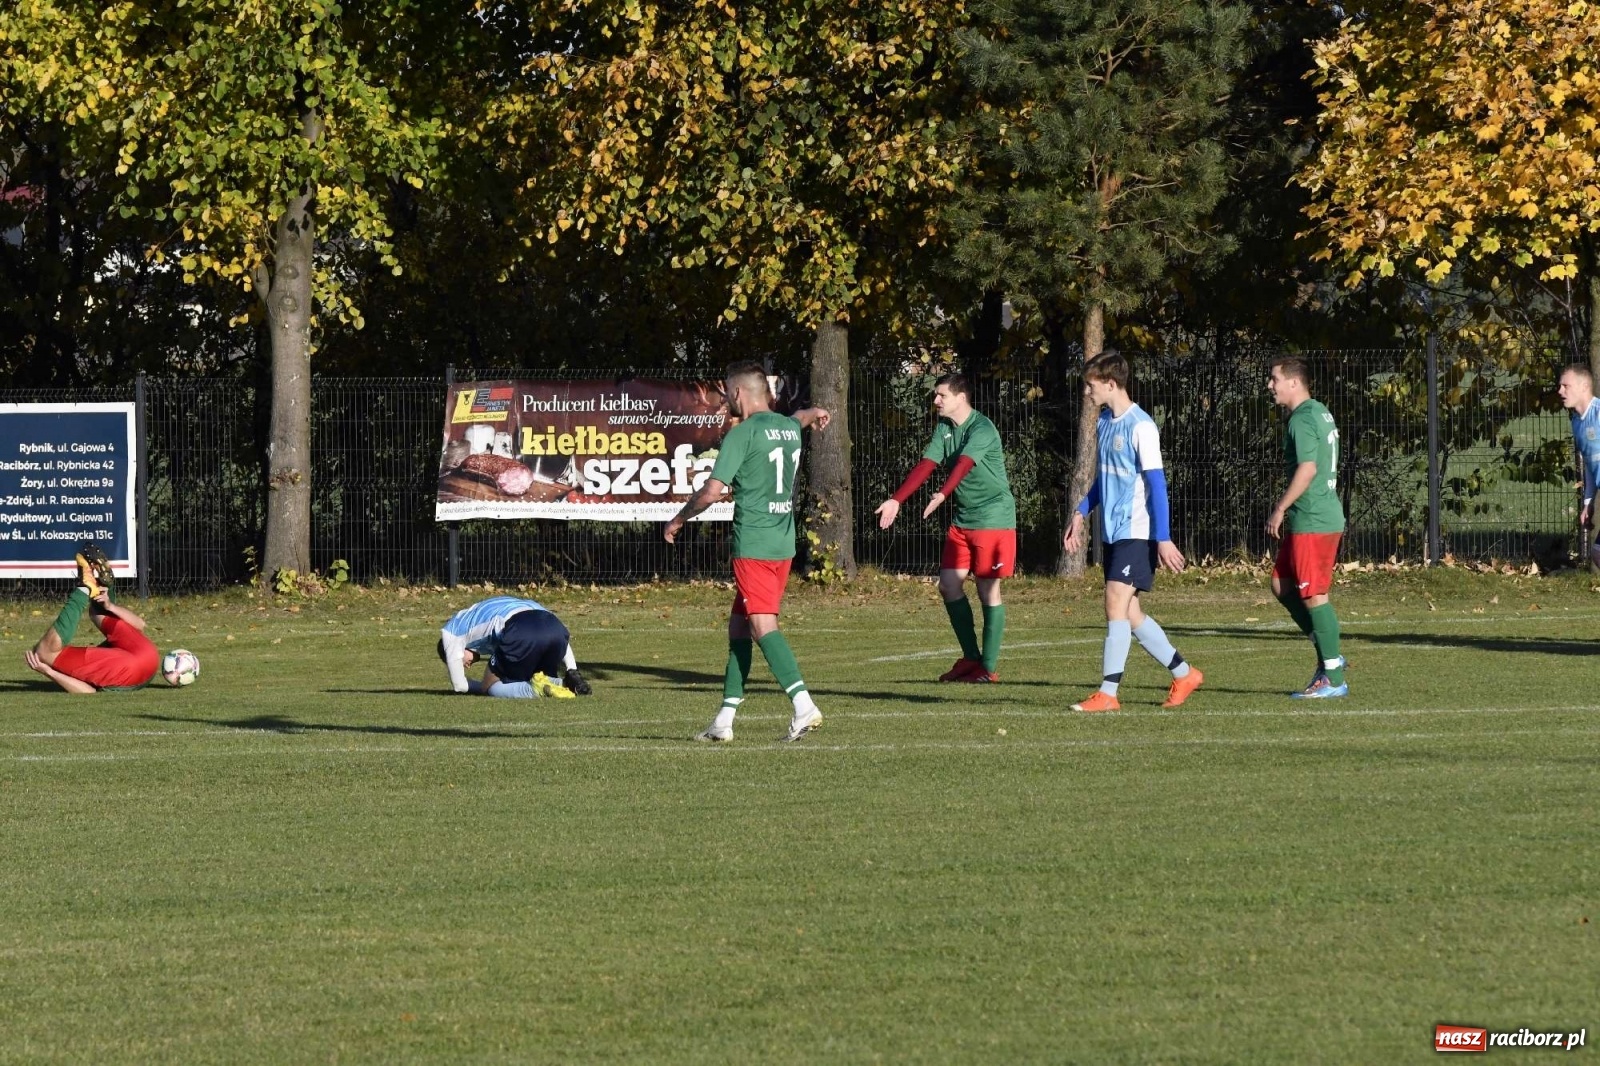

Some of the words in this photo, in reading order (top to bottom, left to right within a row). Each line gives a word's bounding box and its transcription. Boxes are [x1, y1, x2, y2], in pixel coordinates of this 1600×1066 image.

[522, 394, 596, 412] Producent
[600, 393, 657, 416] kiełbasy
[607, 410, 727, 429] surowo-dojrzewającej
[520, 425, 668, 455] kiełbasa
[19, 443, 55, 454] Rybnik,
[57, 443, 69, 452] ul.
[71, 443, 106, 454] Gajowa
[107, 443, 115, 452] 4
[43, 460, 55, 470] ul.
[57, 460, 101, 472] Rybnicka
[102, 460, 115, 470] 42
[20, 475, 45, 489] Żory,
[47, 477, 59, 488] ul.
[60, 477, 100, 489] Okrężna
[102, 478, 114, 488] 9a
[36, 495, 48, 505] ul.
[49, 495, 59, 505] R.
[61, 495, 105, 505] Ranoszka
[106, 495, 114, 505] 4
[0, 513, 54, 525] Rydułtowy,
[56, 513, 68, 522] ul.
[69, 513, 103, 525] Gajowa
[104, 513, 113, 522] 11
[27, 530, 39, 540] ul.
[40, 530, 94, 542] Kokoszycka
[95, 530, 114, 540] 131c
[1122, 564, 1131, 577] 4
